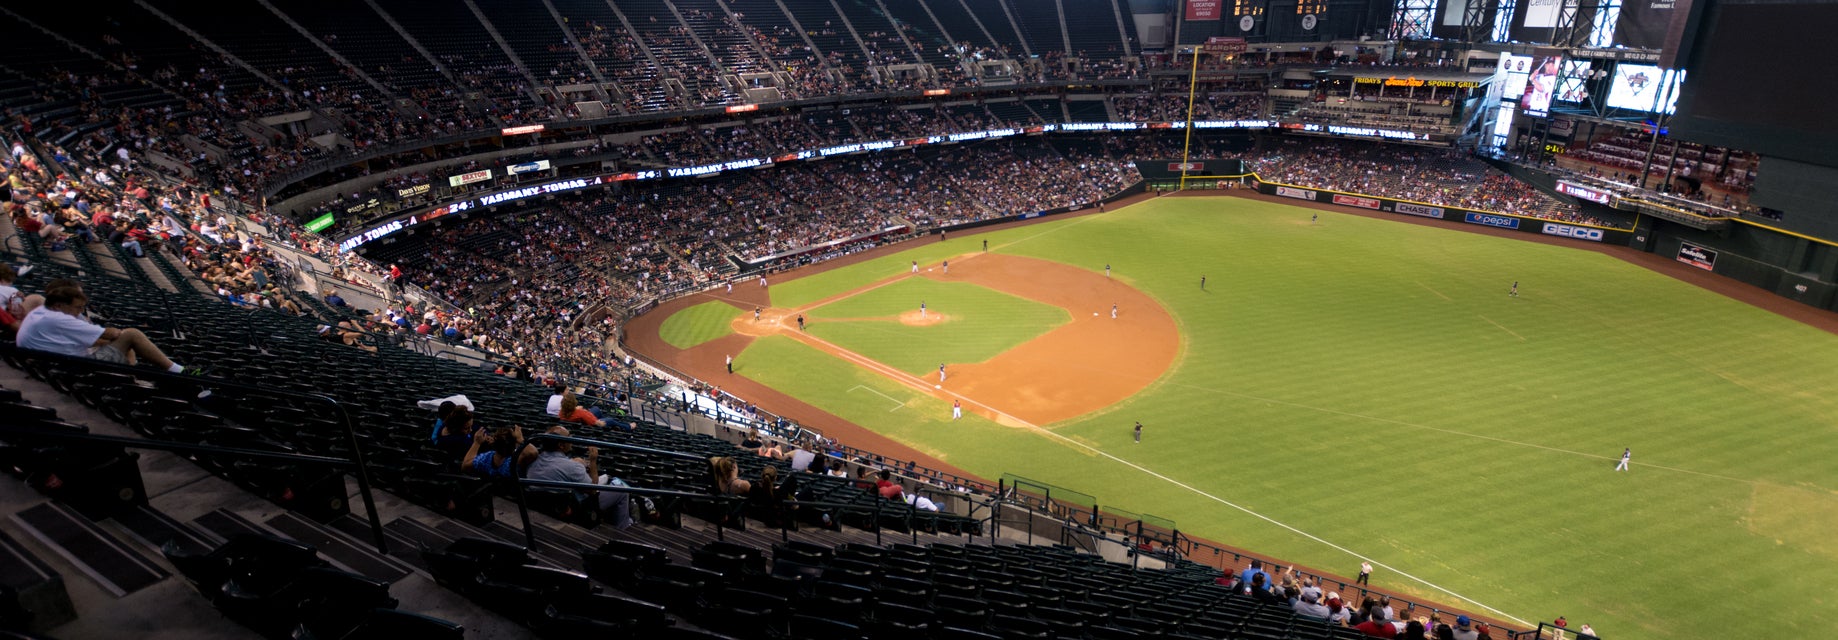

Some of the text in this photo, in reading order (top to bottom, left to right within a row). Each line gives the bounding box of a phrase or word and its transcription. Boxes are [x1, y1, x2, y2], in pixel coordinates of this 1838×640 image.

[1354, 77, 1381, 85] FRIDAYS
[1428, 80, 1456, 88] SPORTS
[1457, 81, 1480, 89] GRILL
[949, 131, 986, 142] YASMANY
[988, 128, 1015, 137] TOMAS
[1328, 125, 1376, 137] YASMANY
[1378, 129, 1416, 140] TOMAS
[820, 144, 861, 156] YASMANY
[864, 140, 895, 151] TOMAS
[637, 169, 656, 180] 24
[667, 164, 723, 178] YASMANY
[725, 158, 761, 170] TOMAS
[461, 171, 488, 182] SEXTON
[449, 201, 469, 214] 24
[479, 186, 540, 206] YASMANY
[542, 179, 588, 194] TOMAS
[1399, 204, 1430, 214] CHASE
[1482, 215, 1512, 227] pepsi
[364, 220, 403, 241] TOMAS
[1543, 222, 1604, 241] GEICO
[1681, 247, 1707, 260] Safelite
